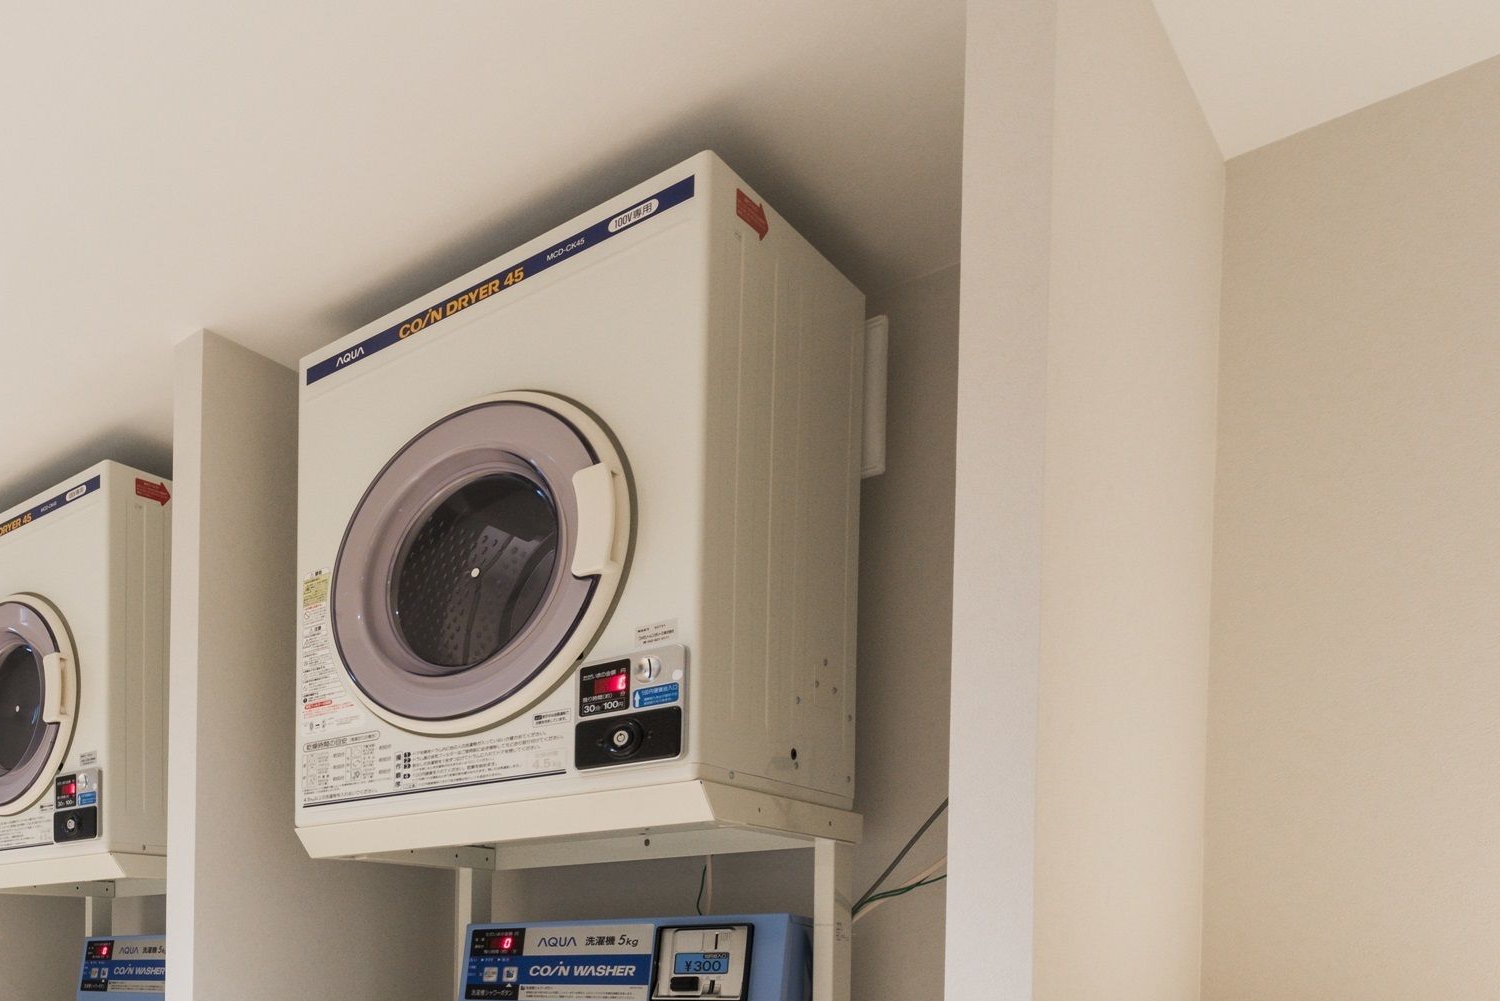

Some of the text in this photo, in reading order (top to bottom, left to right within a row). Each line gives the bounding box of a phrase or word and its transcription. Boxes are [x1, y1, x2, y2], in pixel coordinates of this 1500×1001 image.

[614, 202, 652, 229] 100V専用
[546, 237, 585, 262] MCD-CK45
[398, 266, 525, 339] COIN DRYER 45
[336, 346, 364, 368] AQUA
[22, 513, 32, 525] 45
[503, 937, 512, 949] 0
[537, 934, 639, 948] AQUA 洗濯機 5kg
[119, 946, 139, 955] AQUA
[529, 961, 636, 977] COIN WASHER
[685, 960, 722, 972] ¥300
